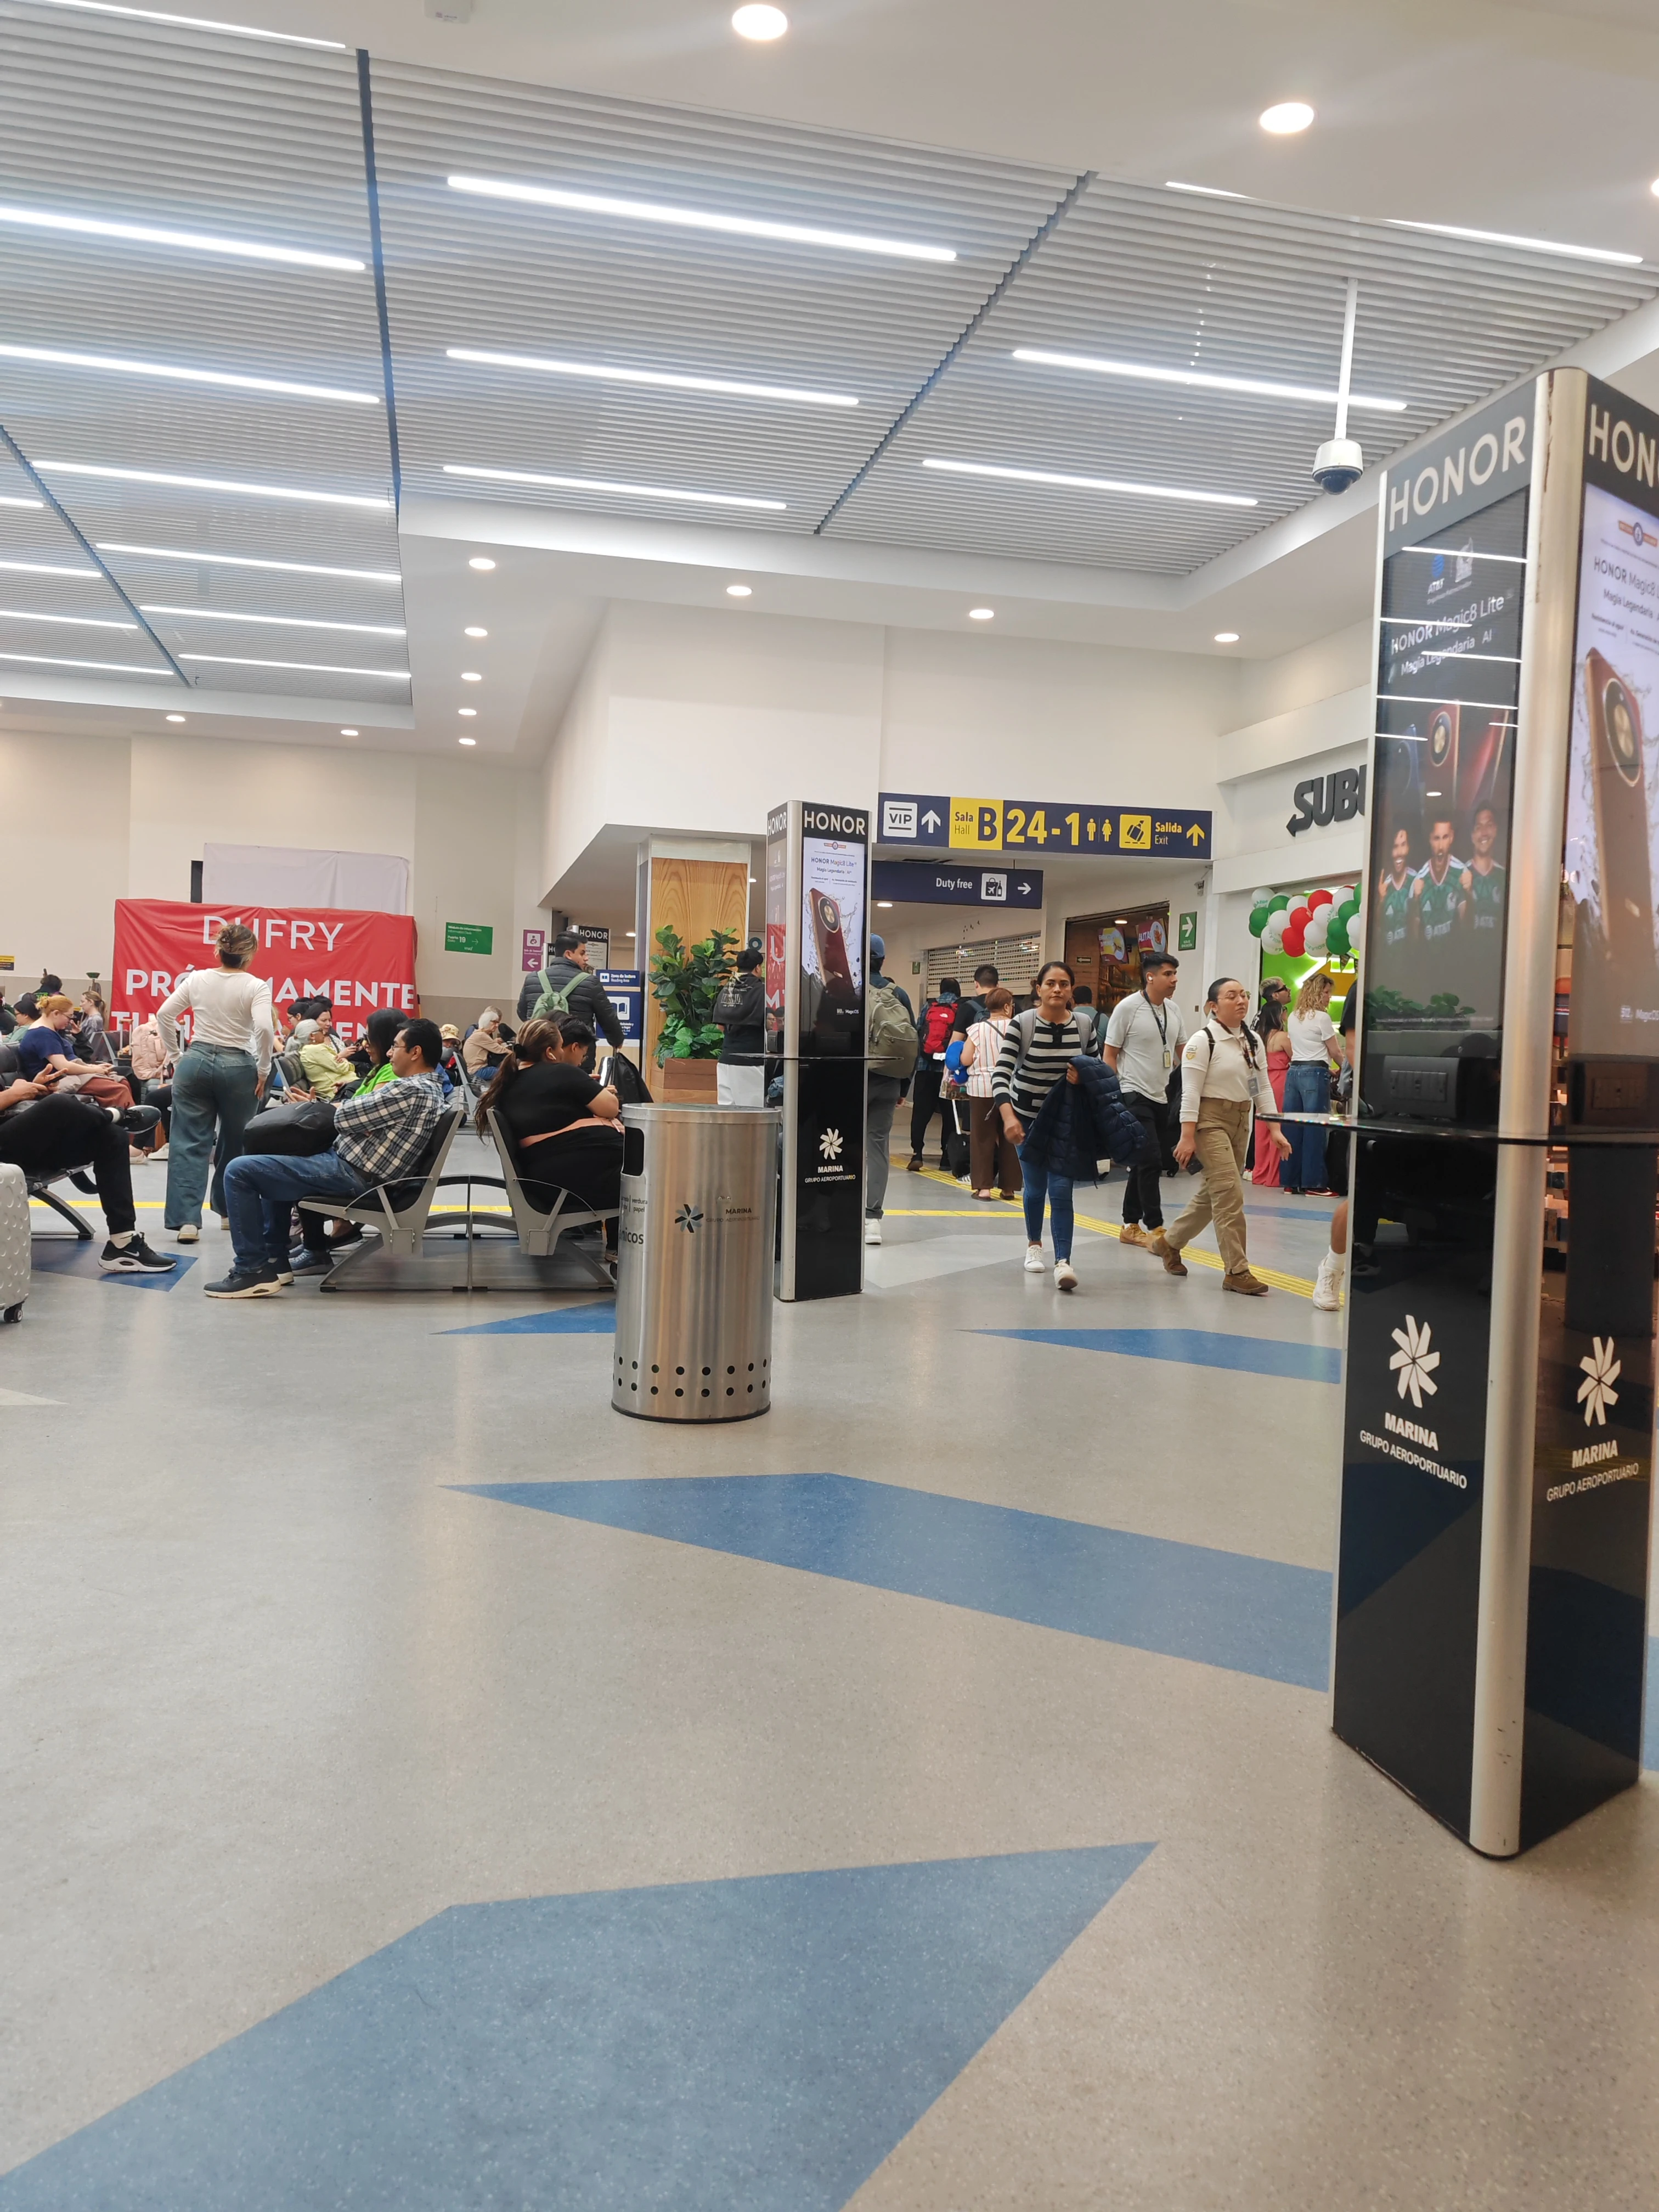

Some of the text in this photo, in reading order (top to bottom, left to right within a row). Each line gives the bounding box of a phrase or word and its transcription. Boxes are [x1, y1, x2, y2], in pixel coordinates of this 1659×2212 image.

[1589, 403, 1659, 488] HON
[1389, 416, 1526, 532] HONOR
[1594, 556, 1627, 584] HONOR
[1427, 578, 1445, 594] AT&T
[1391, 596, 1504, 655] HONOR Magic8 Lite
[1401, 629, 1492, 675] Magia Legendaria AI
[768, 811, 787, 837] HONOR
[804, 810, 866, 836] HONOR
[889, 813, 912, 825] VIP
[955, 811, 974, 822] Sala
[978, 806, 1080, 846] B 24-1
[1155, 822, 1182, 834] Salida
[955, 825, 970, 835] Hall
[1154, 835, 1169, 845] Exit
[936, 877, 973, 891] Duty free
[579, 929, 608, 940] HONOR
[817, 1165, 843, 1173] MARINA
[619, 1227, 644, 1245] nicos
[1384, 1412, 1438, 1451] MARINA
[1359, 1430, 1468, 1489] GRUPO AEROPORTUARIO
[1572, 1439, 1618, 1469] MARINA
[1546, 1463, 1639, 1502] GRUPO AEROPORTUARIO
